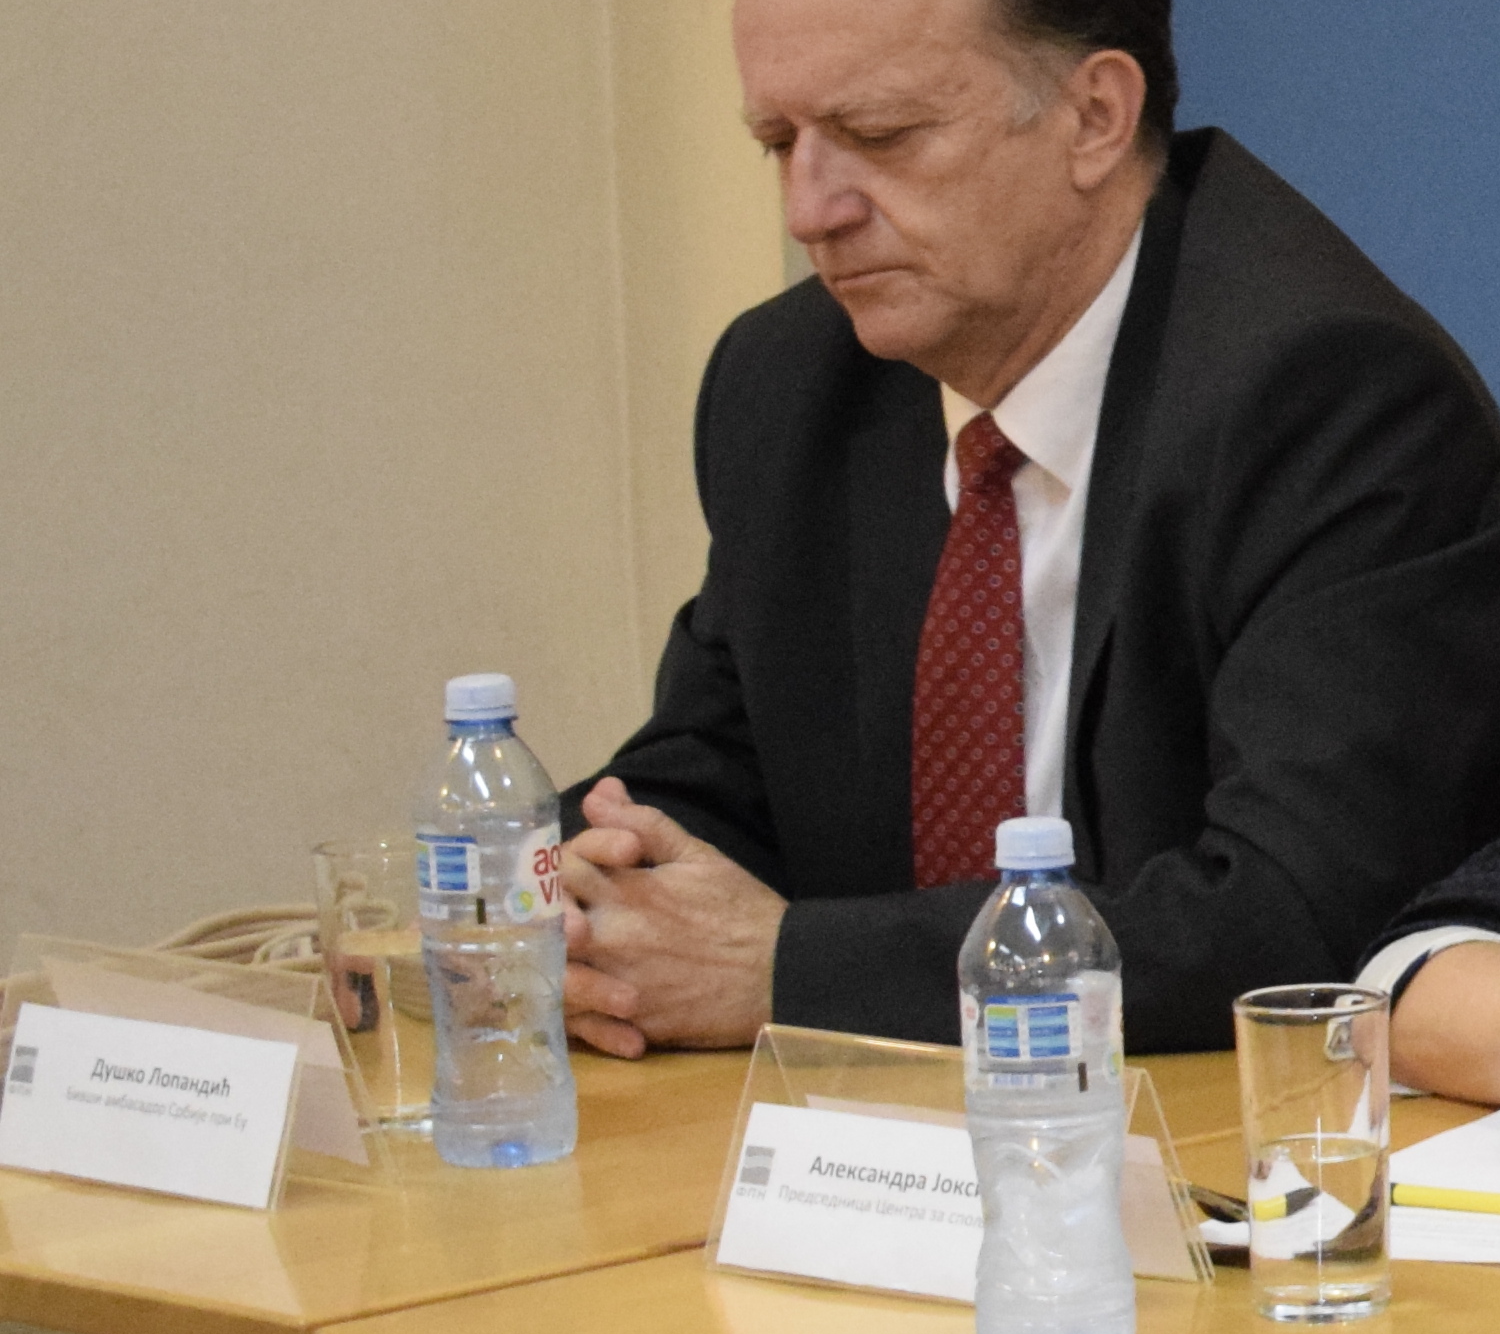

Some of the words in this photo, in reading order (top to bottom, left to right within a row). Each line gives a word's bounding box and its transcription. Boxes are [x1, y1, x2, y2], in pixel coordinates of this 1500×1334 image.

[90, 1058, 146, 1083] Душко
[148, 1067, 231, 1097] Лопандић
[809, 1155, 927, 1194] Александра
[778, 1185, 873, 1214] Председница
[875, 1198, 926, 1222] Центра
[947, 1210, 985, 1228] спољ
